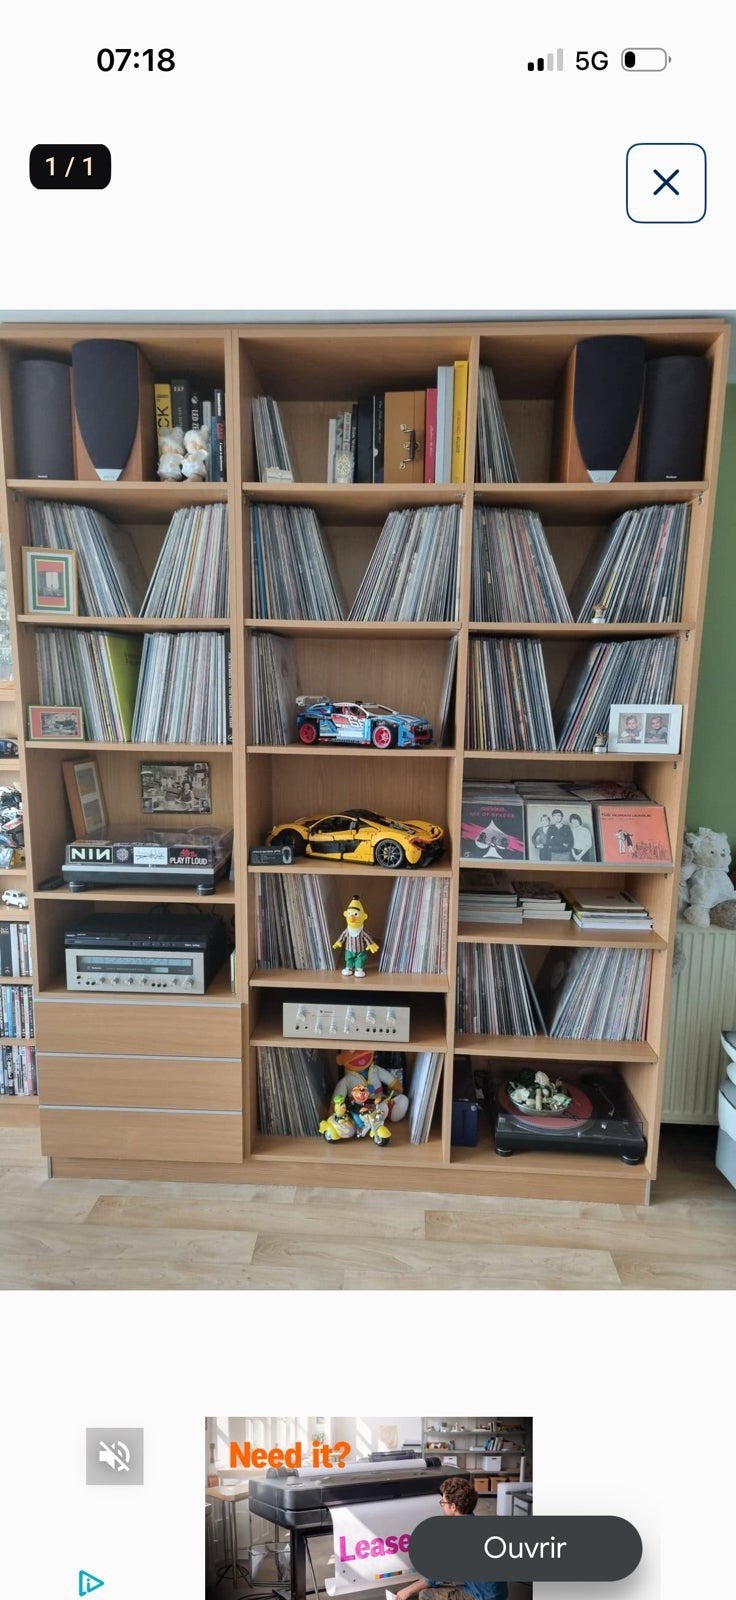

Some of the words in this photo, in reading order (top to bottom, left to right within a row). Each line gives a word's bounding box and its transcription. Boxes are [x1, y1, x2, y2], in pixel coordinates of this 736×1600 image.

[72, 848, 110, 860] NIN
[169, 856, 184, 865] PLAY
[191, 857, 208, 865] LOUD
[230, 1441, 302, 1469] Need
[312, 1440, 351, 1468] it?
[339, 1533, 411, 1563] Lease
